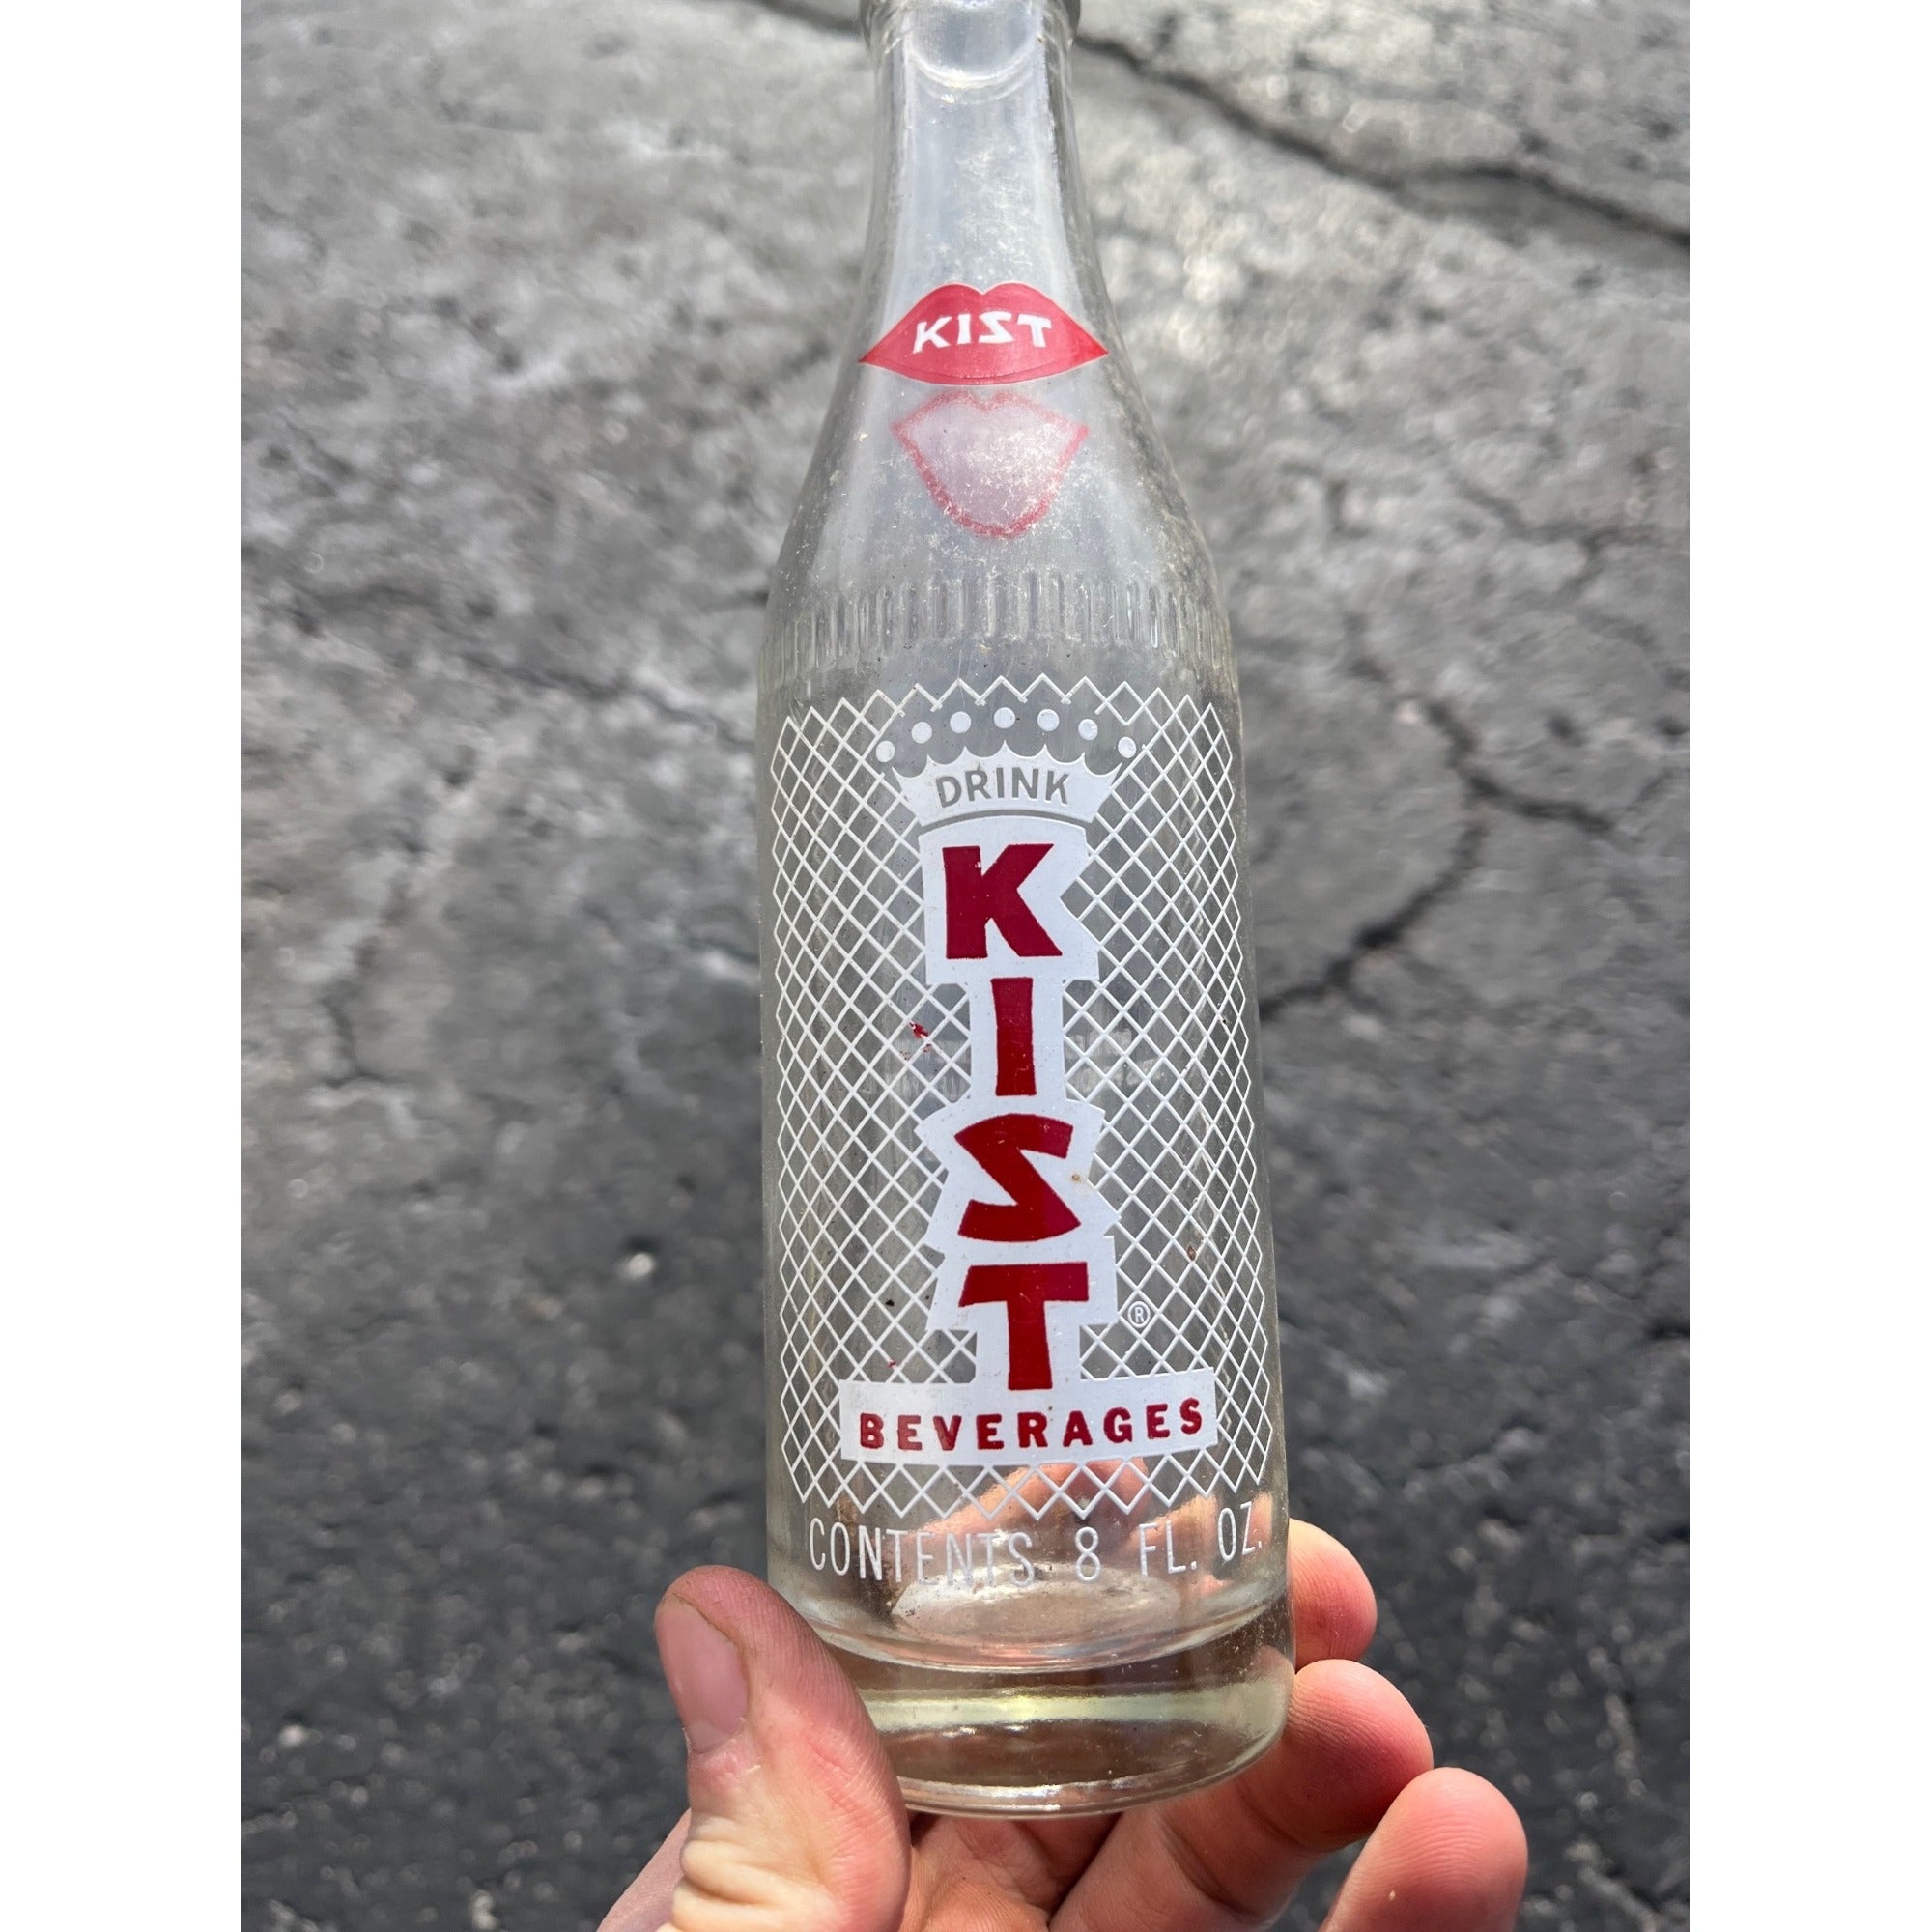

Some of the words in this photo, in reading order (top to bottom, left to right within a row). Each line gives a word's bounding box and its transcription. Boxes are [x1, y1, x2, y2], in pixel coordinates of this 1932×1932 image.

[911, 310, 1053, 355] KIST
[935, 766, 1071, 809] DRINK
[941, 842, 1090, 1391] KIST
[859, 1397, 1204, 1451] BEVERAGES
[808, 1516, 1036, 1588] CONTENTS
[1074, 1525, 1102, 1583] 8
[1138, 1521, 1198, 1577] FL.
[1216, 1499, 1264, 1562] OZ.
